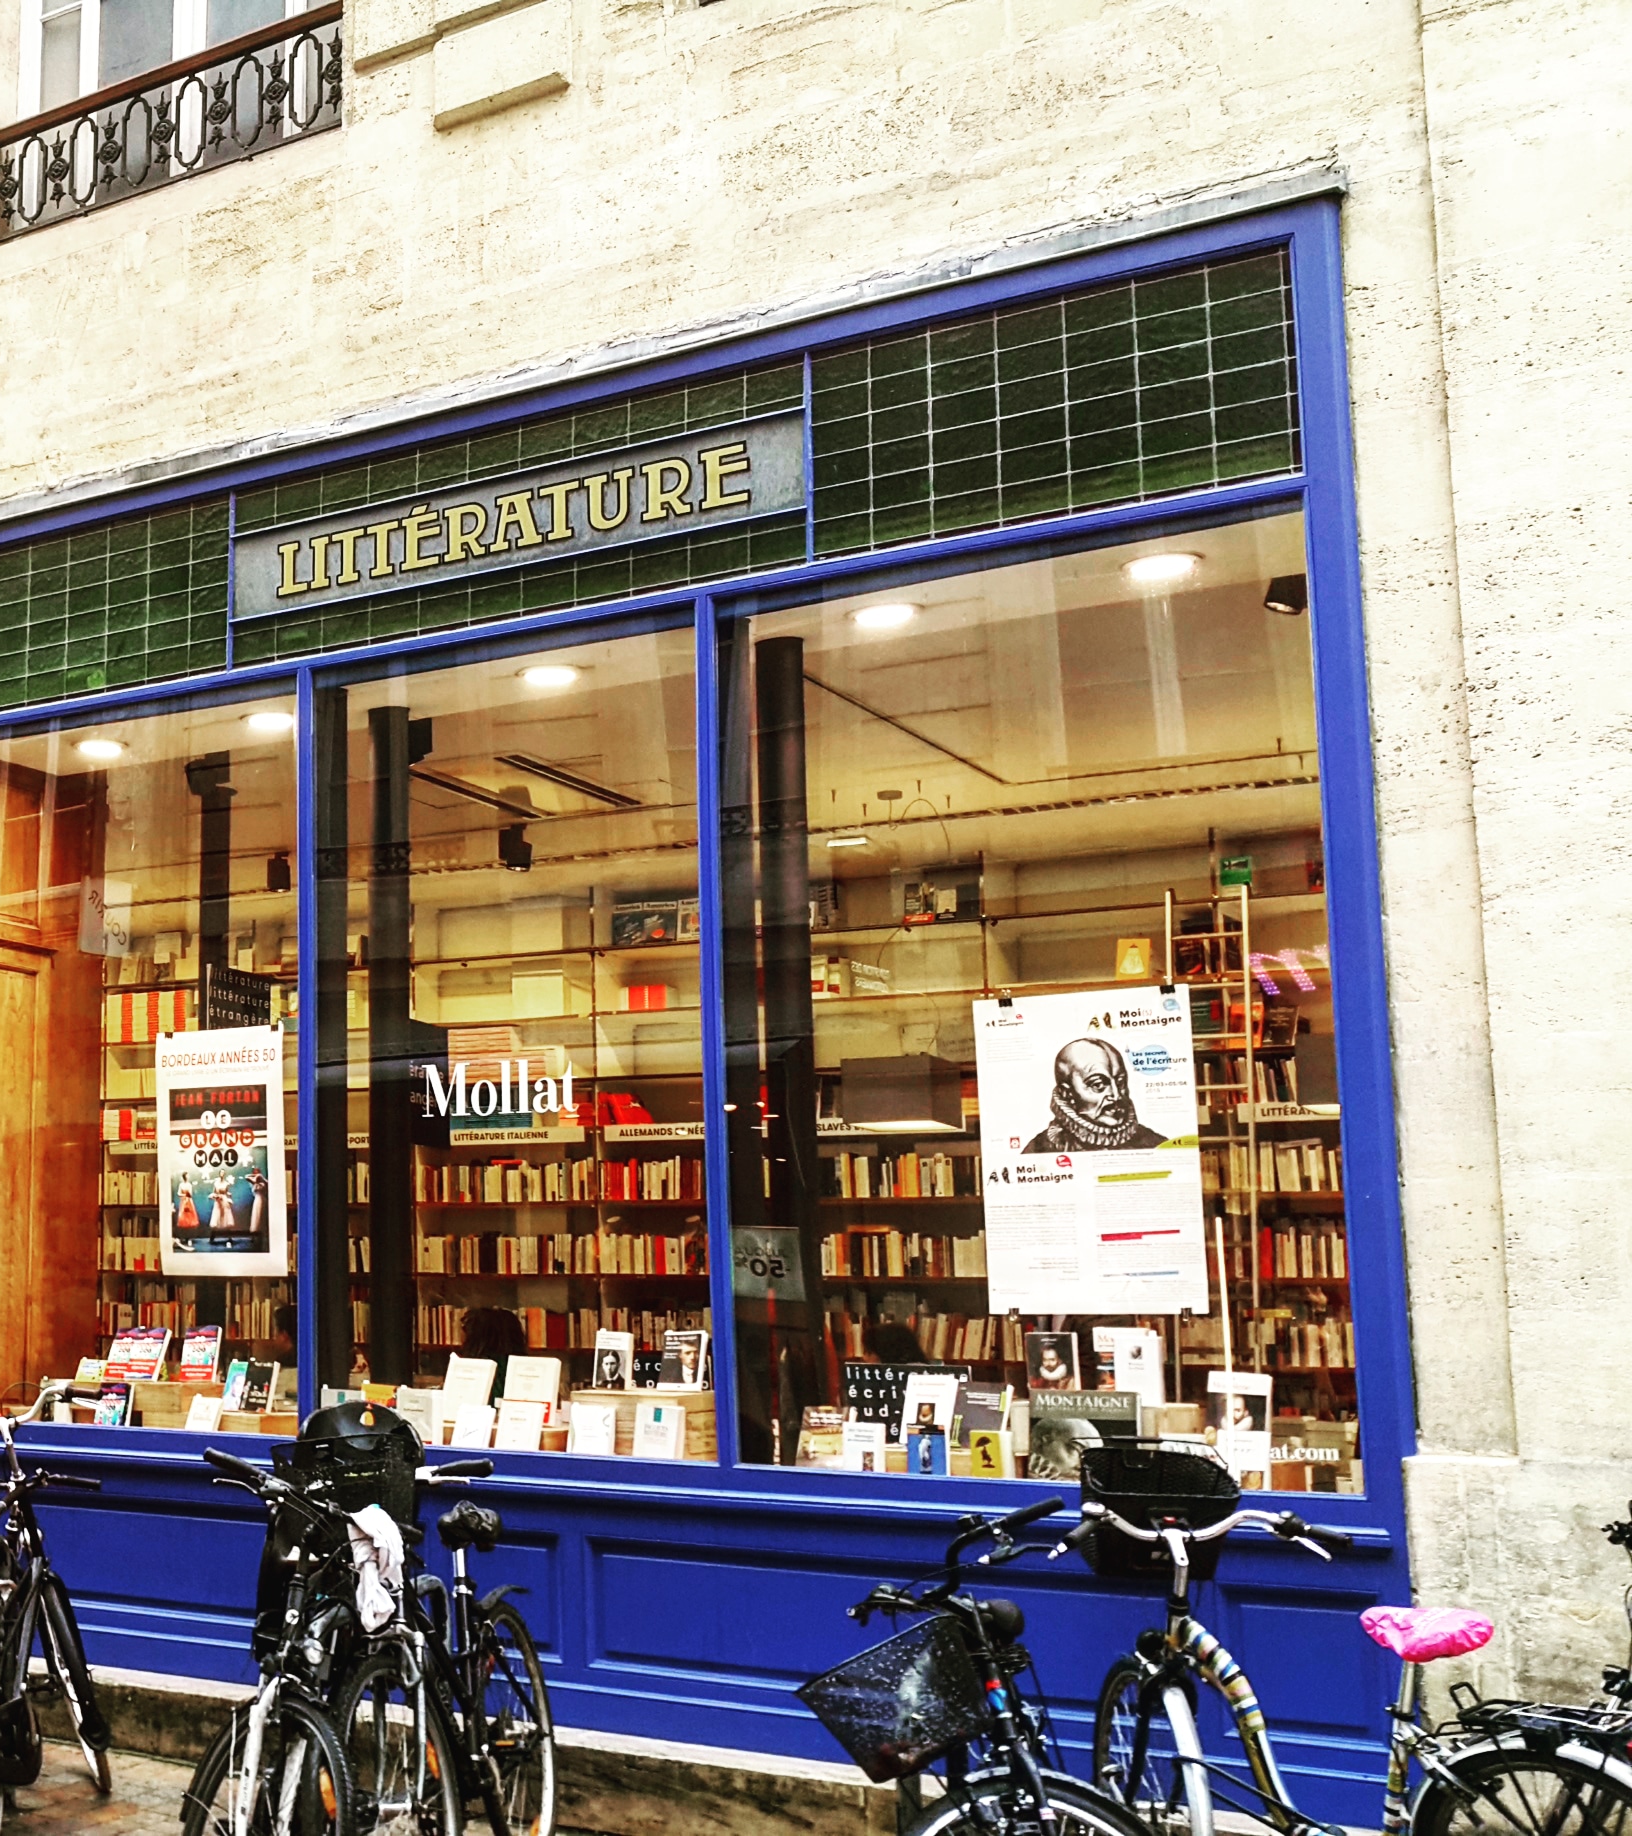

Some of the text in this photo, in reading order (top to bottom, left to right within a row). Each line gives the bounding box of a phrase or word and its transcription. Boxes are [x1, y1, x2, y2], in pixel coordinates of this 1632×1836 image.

[276, 440, 751, 597] LITTÉRATURE
[210, 968, 270, 991] littérature
[209, 985, 270, 1009] littérature
[209, 1004, 270, 1026] étrangère
[1120, 1015, 1183, 1028] Montaigne
[161, 1046, 276, 1068] BORDEAUX ANNÉES 50
[1132, 1058, 1145, 1066] de
[421, 1059, 580, 1118] Mollat
[175, 1089, 260, 1108] JEAN FORTON
[181, 1130, 254, 1146] GRAND
[454, 1130, 549, 1142] LITTÉRATURE ITALIENNE
[619, 1127, 673, 1137] ALLEMANDS
[195, 1151, 237, 1166] MAL
[1016, 1164, 1036, 1174] Moi
[1017, 1173, 1074, 1184] Montaigne
[1035, 1393, 1130, 1409] MONTAIGNE
